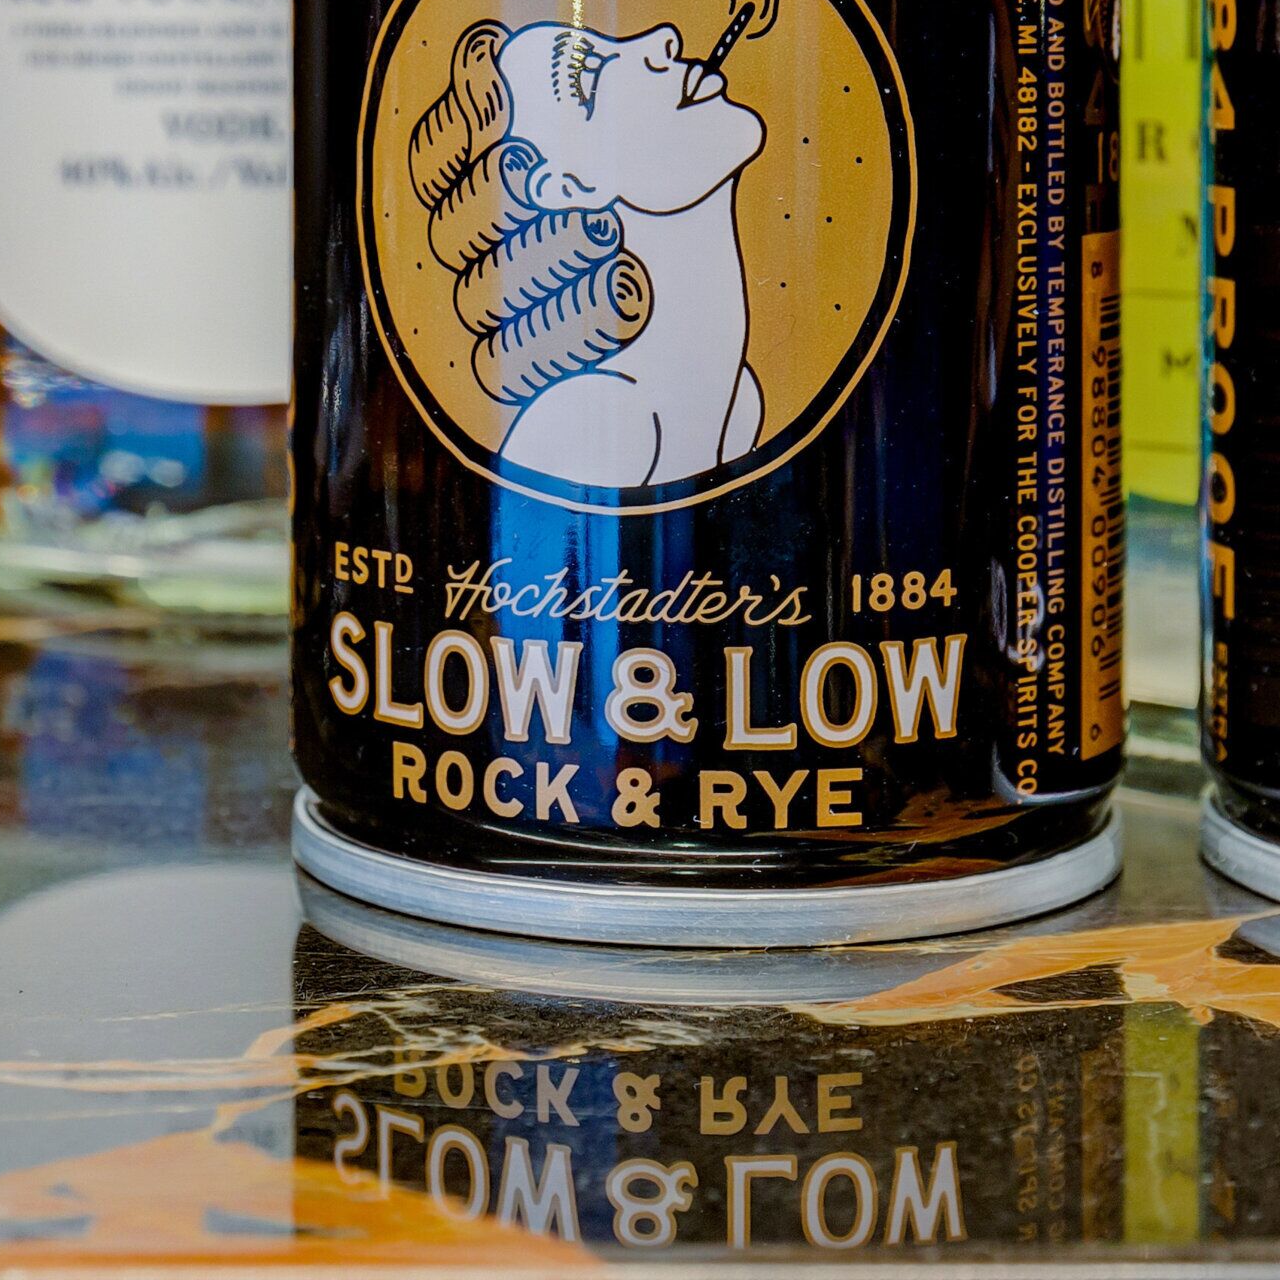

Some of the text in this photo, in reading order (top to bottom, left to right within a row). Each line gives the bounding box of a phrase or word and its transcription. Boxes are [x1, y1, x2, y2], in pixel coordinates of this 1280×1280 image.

[1018, 25, 1037, 55] MI
[1047, 17, 1065, 71] AND
[1018, 66, 1037, 152] 48182
[1047, 82, 1065, 205] BOTTLED
[1047, 216, 1065, 247] BY
[1018, 183, 1038, 373] EXCLUSIVELY
[1046, 263, 1065, 447] TEMPERANCE
[1018, 387, 1038, 441] FOR
[1018, 452, 1038, 503] THE
[1017, 516, 1038, 629] COOPER
[1045, 458, 1065, 612] DISTILLING
[444, 558, 813, 626] Hochstadter's
[851, 568, 958, 613] 1884
[328, 611, 968, 751] SLOW & LOW
[1017, 639, 1038, 749] SPIRITS
[1045, 621, 1065, 756] COMPANY
[393, 742, 864, 830] ROCK & RYE
